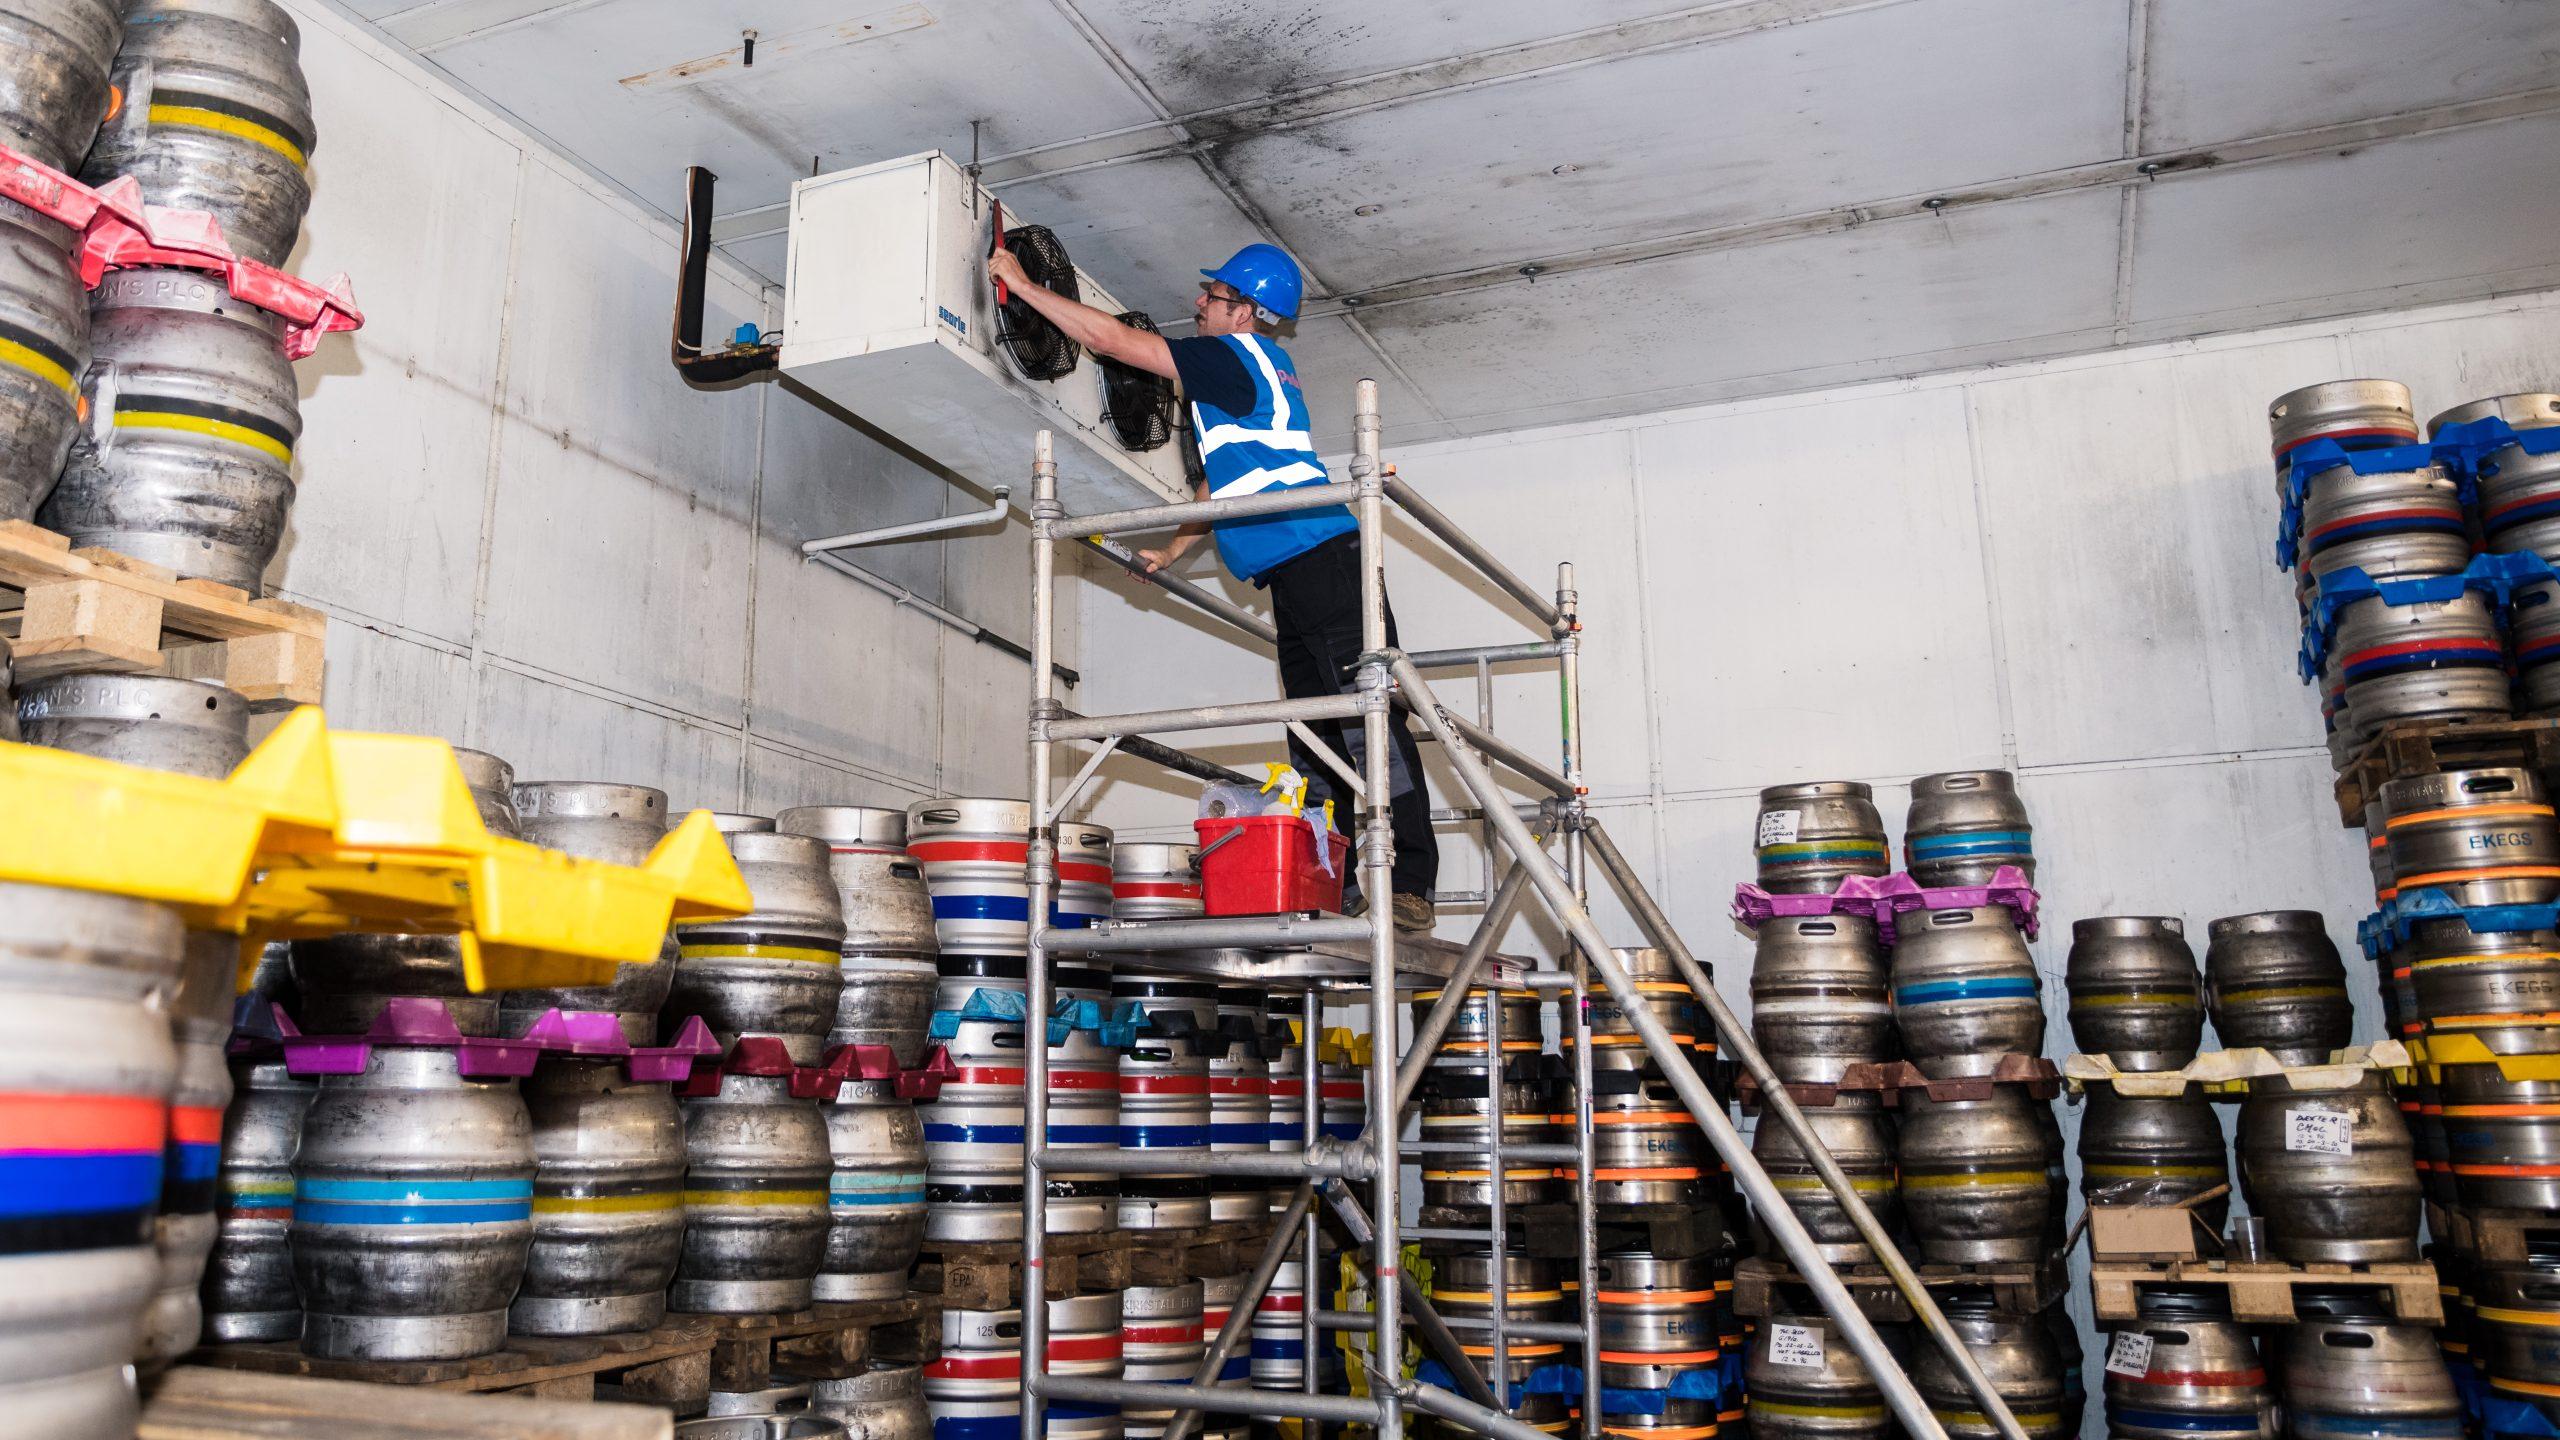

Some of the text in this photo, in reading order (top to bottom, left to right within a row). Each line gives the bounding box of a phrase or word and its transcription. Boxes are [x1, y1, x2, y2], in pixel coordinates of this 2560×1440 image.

[938, 305, 966, 335] searle
[98, 686, 151, 709] PLC
[994, 811, 1029, 827] KIRKS
[2469, 832, 2533, 850] EKEGS
[2488, 980, 2553, 996] EKEGS
[1458, 1012, 1508, 1026] EKES
[1123, 1298, 1176, 1312] KIRKSTALL
[976, 1325, 994, 1337] 125
